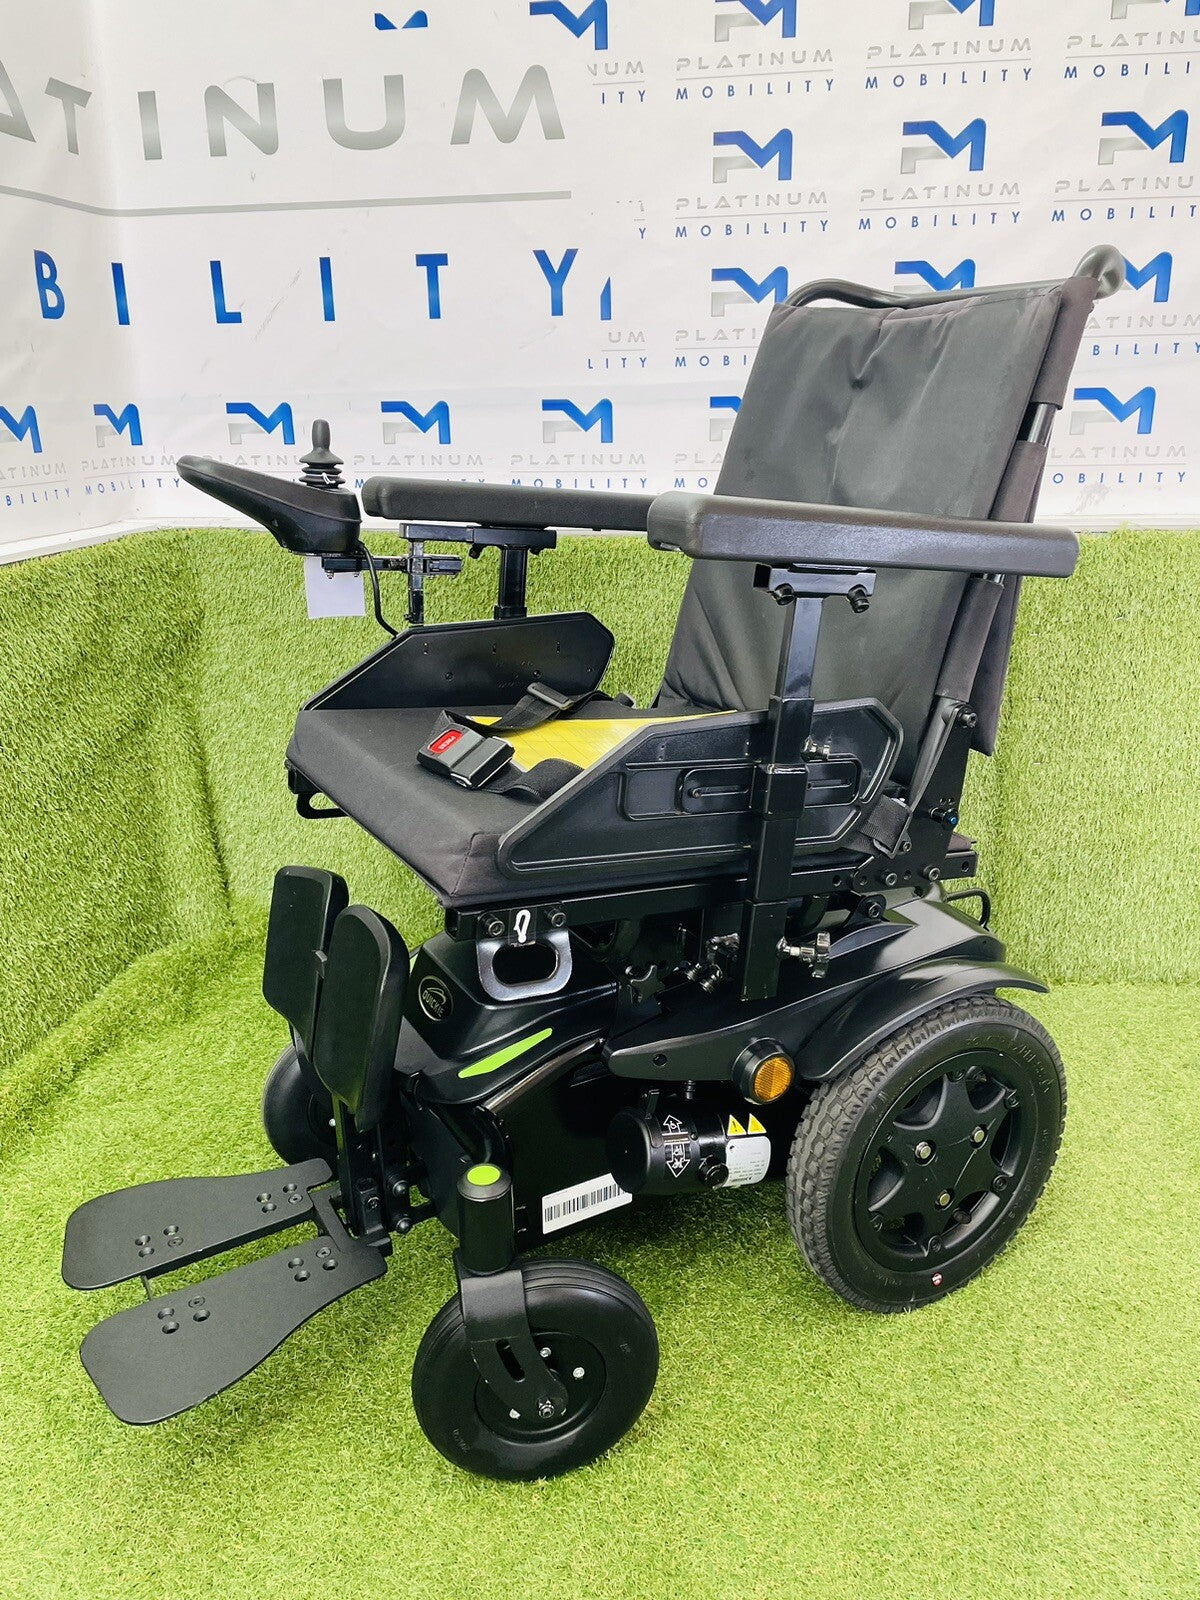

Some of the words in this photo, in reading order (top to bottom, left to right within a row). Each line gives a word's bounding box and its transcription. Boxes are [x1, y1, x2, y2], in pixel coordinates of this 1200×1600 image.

[866, 37, 1032, 60] PLATINUM
[675, 48, 834, 71] PLATINUM
[865, 67, 1032, 90] MOBILITY
[1064, 61, 1191, 80] MOBILI
[601, 89, 646, 105] ITY
[675, 78, 834, 101] MOBILITY
[675, 191, 828, 211] PLATINUM
[860, 182, 1021, 202] PLATINUM
[674, 219, 829, 239] MOBILITY
[858, 210, 1021, 231] MOBILITY
[33, 248, 579, 326] BILITY
[674, 327, 756, 342] PLATI
[587, 356, 647, 370] LITY
[674, 354, 747, 368] MOBI
[353, 453, 484, 466] PLATINUM
[510, 452, 646, 466] PLATINUM
[1050, 445, 1186, 459] LATINUM
[82, 454, 176, 472] PLATINUM
[84, 477, 181, 496] MOBILITY
[511, 477, 648, 489] MOBILITY
[674, 476, 708, 488] MO
[1052, 471, 1186, 485] OBILITY
[5, 487, 70, 507] BILITY
